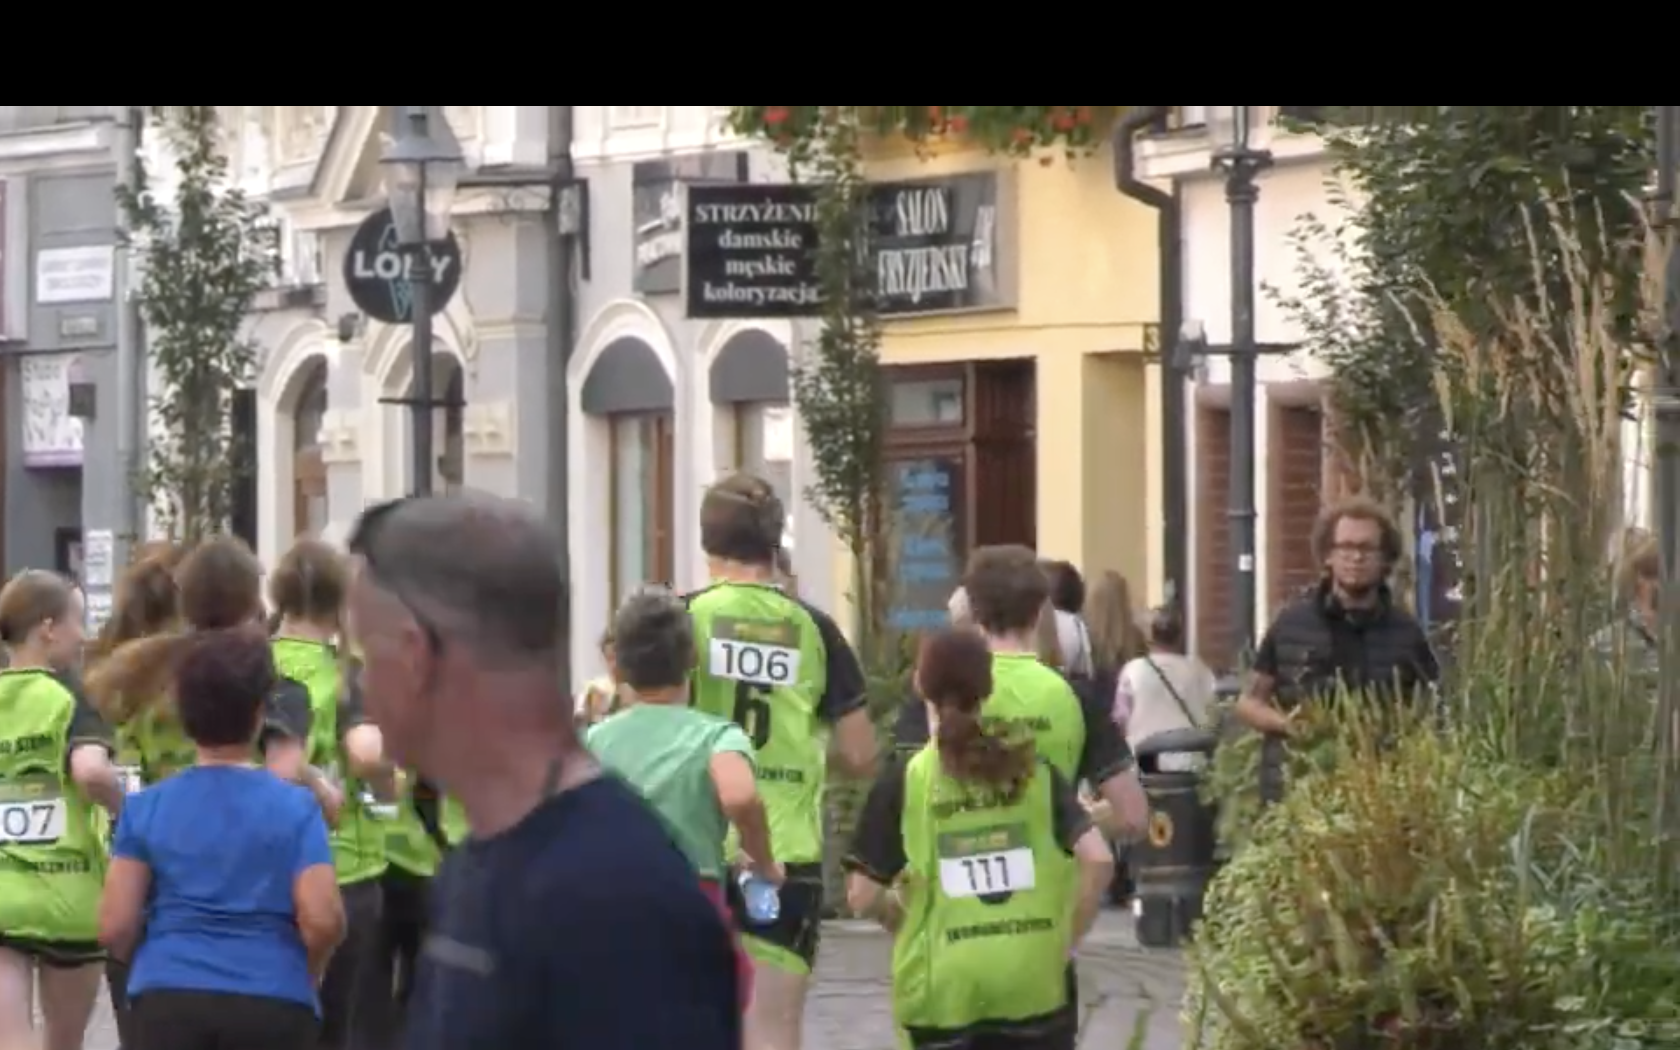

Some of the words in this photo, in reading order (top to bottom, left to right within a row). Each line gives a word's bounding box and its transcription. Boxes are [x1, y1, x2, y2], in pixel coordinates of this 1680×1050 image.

[896, 187, 948, 236] SALON
[717, 229, 802, 248] damskie
[725, 256, 796, 278] męskie
[703, 282, 826, 304] koloryzacja
[721, 642, 790, 682] 106
[961, 855, 1010, 891] 111
